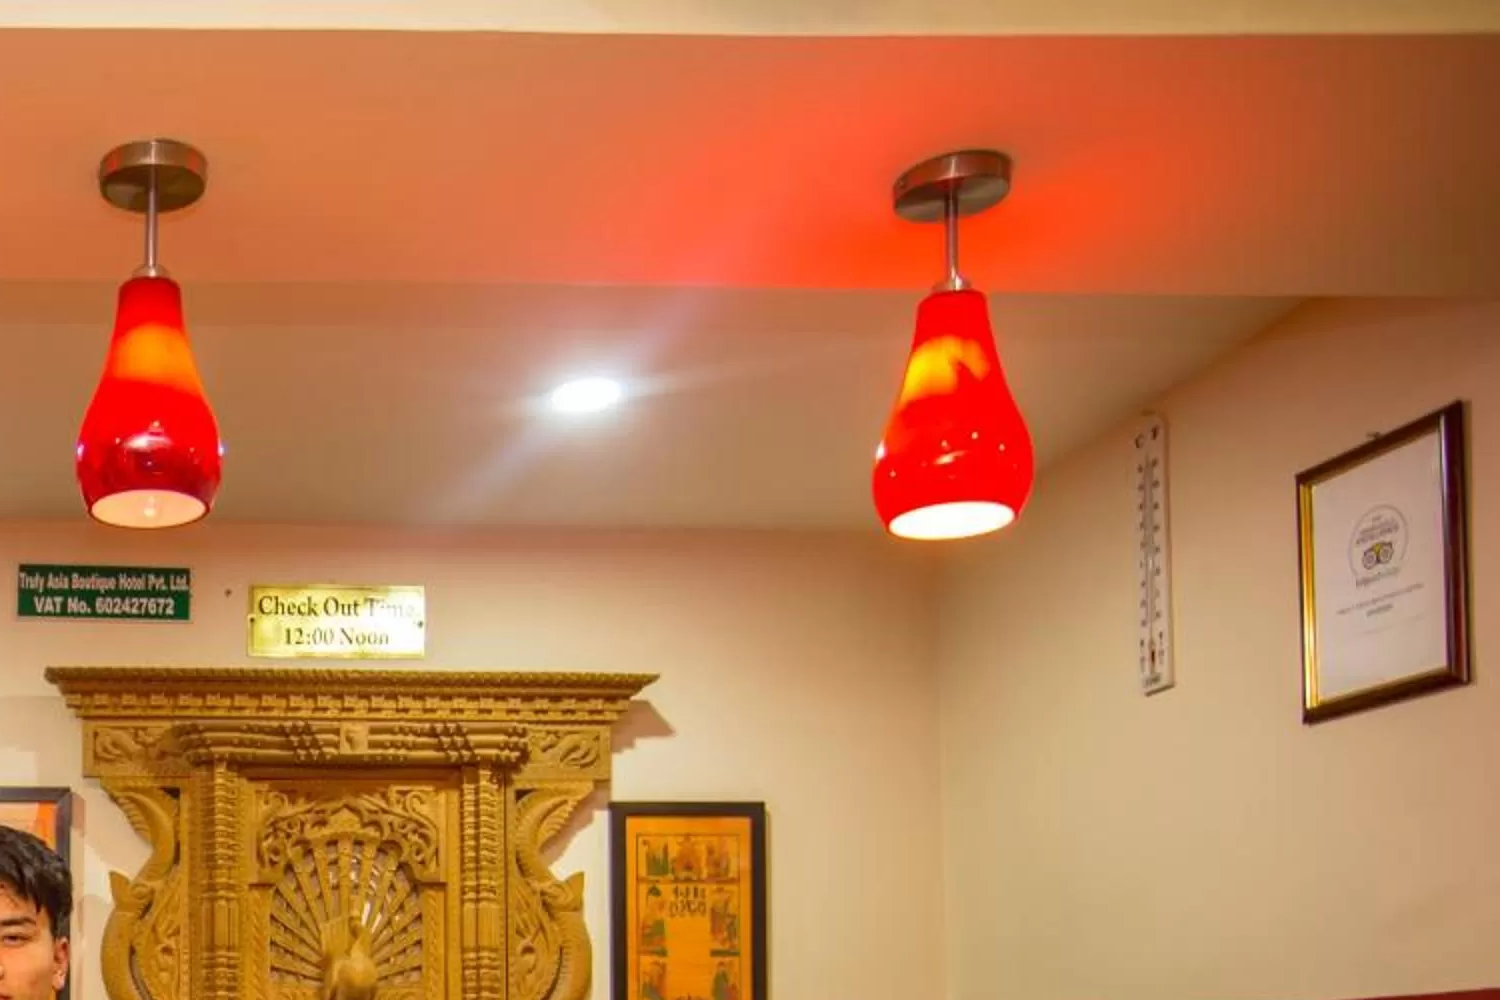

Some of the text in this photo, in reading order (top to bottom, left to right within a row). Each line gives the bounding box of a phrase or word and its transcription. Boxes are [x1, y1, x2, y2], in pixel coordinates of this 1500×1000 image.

[19, 572, 190, 594] Truly Asia Boutique Hotel Pvt. Ltd.
[33, 596, 175, 616] VAT No. 602427672
[258, 595, 319, 617] Check
[323, 596, 360, 617] Out
[284, 627, 390, 646] 12:00 Noon
